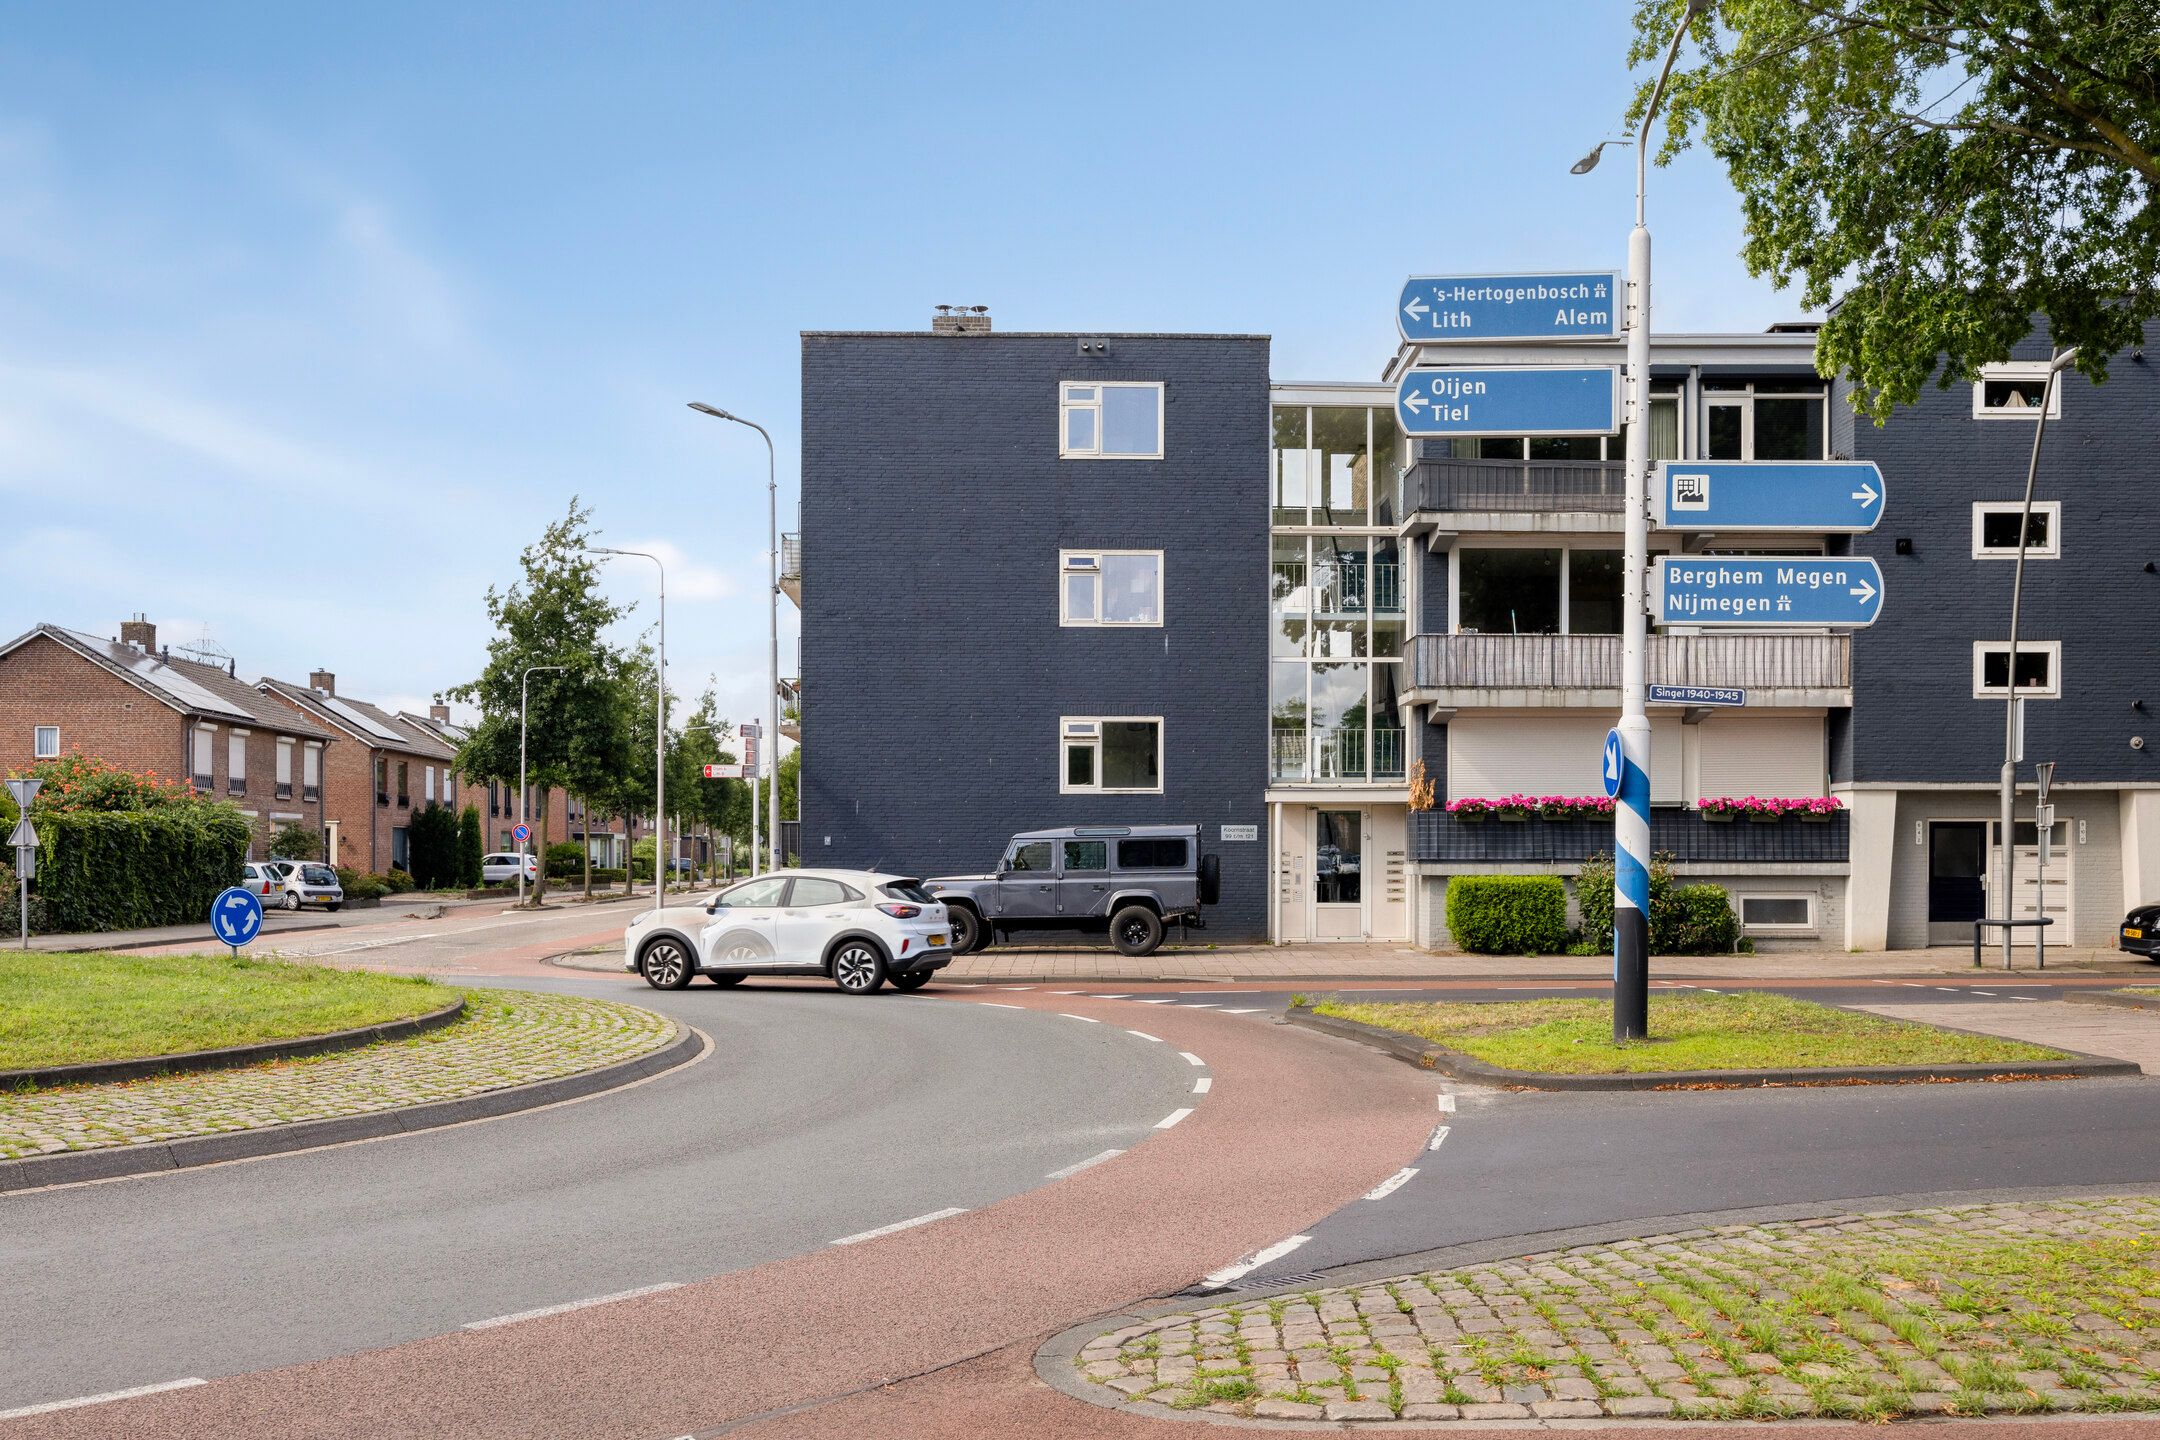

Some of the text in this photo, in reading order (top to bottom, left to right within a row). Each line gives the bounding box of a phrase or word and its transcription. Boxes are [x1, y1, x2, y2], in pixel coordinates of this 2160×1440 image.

[1432, 311, 1471, 328] Lith
[1554, 309, 1608, 326] Alem
[1431, 378, 1486, 399] Oijen
[1431, 404, 1469, 421] Tiel
[1669, 567, 1847, 589] Berghem Megen
[1669, 594, 1770, 615] Nijmegen
[1656, 686, 1739, 701] Singel 1940-1945
